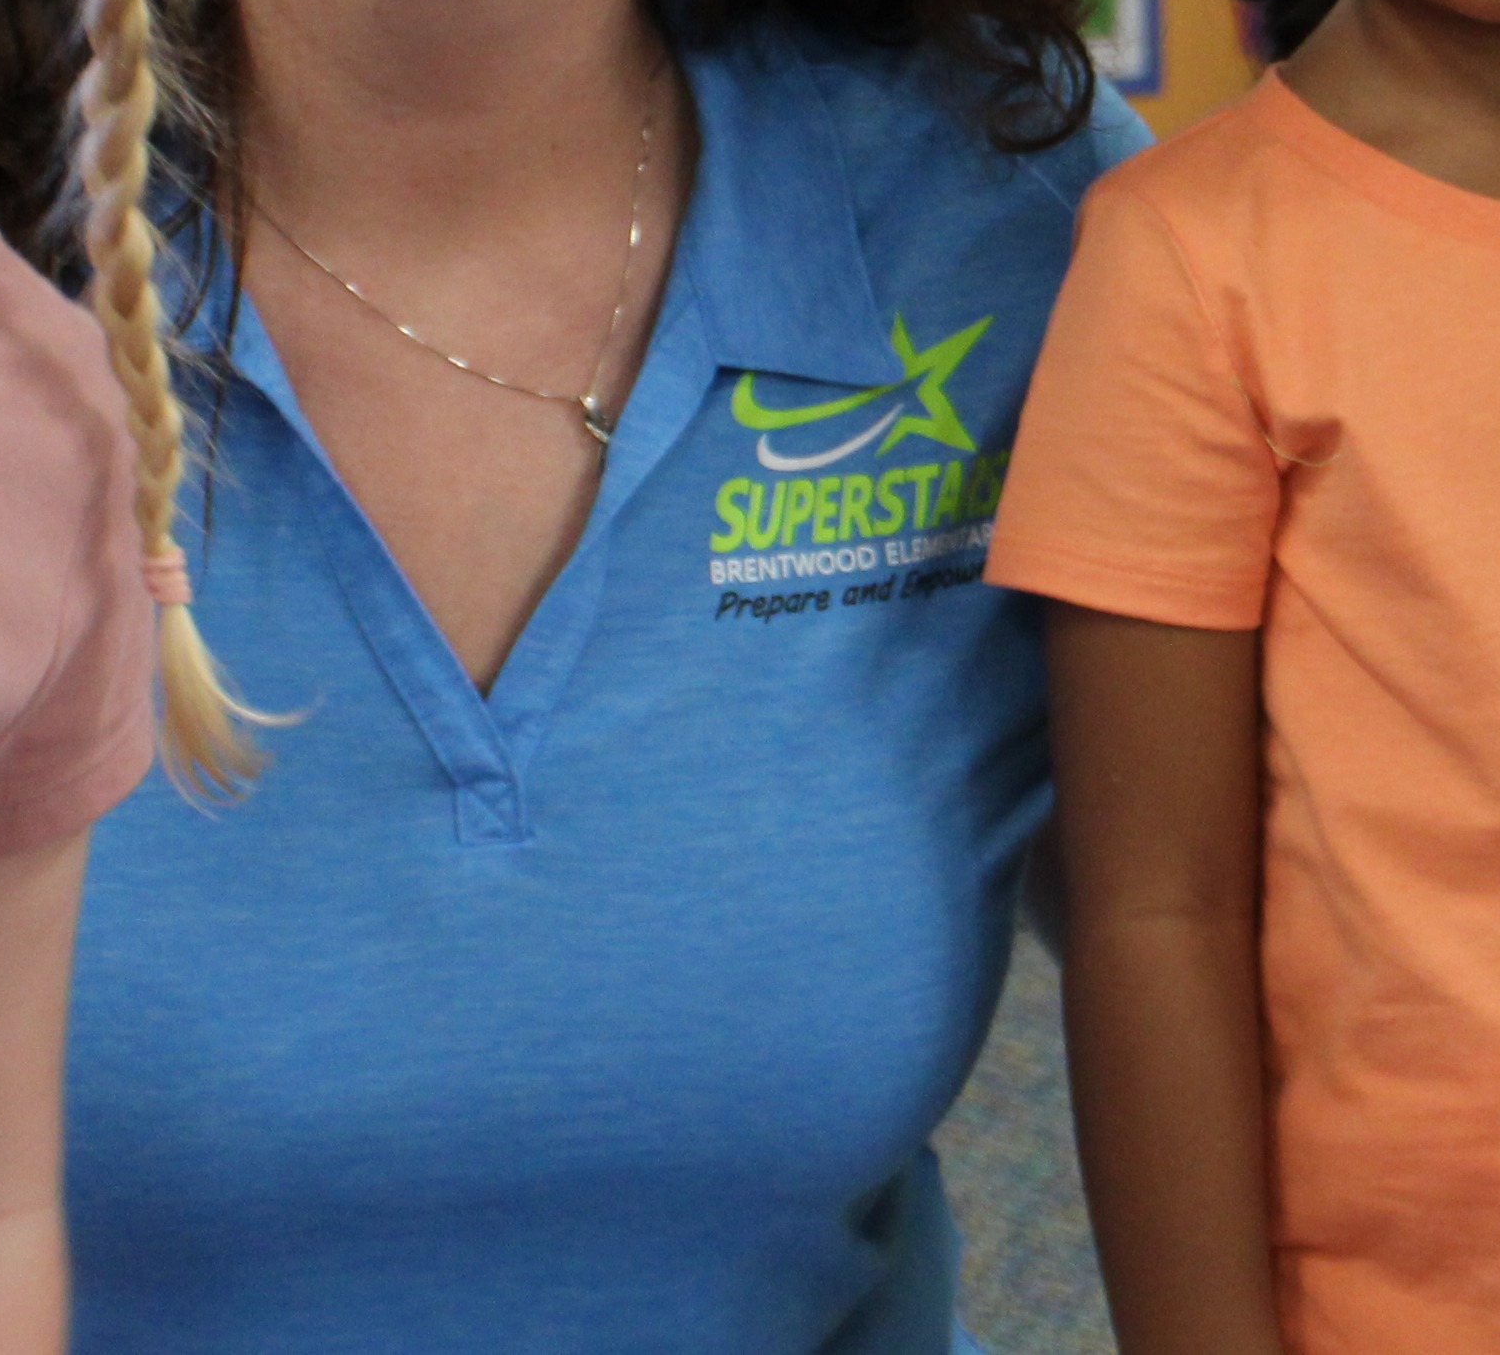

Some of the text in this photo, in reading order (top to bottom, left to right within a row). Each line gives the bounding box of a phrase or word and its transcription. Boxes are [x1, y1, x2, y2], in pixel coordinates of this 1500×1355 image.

[710, 546, 876, 585] BRENTWOOD
[714, 590, 832, 624] Prepare
[842, 573, 898, 607] and
